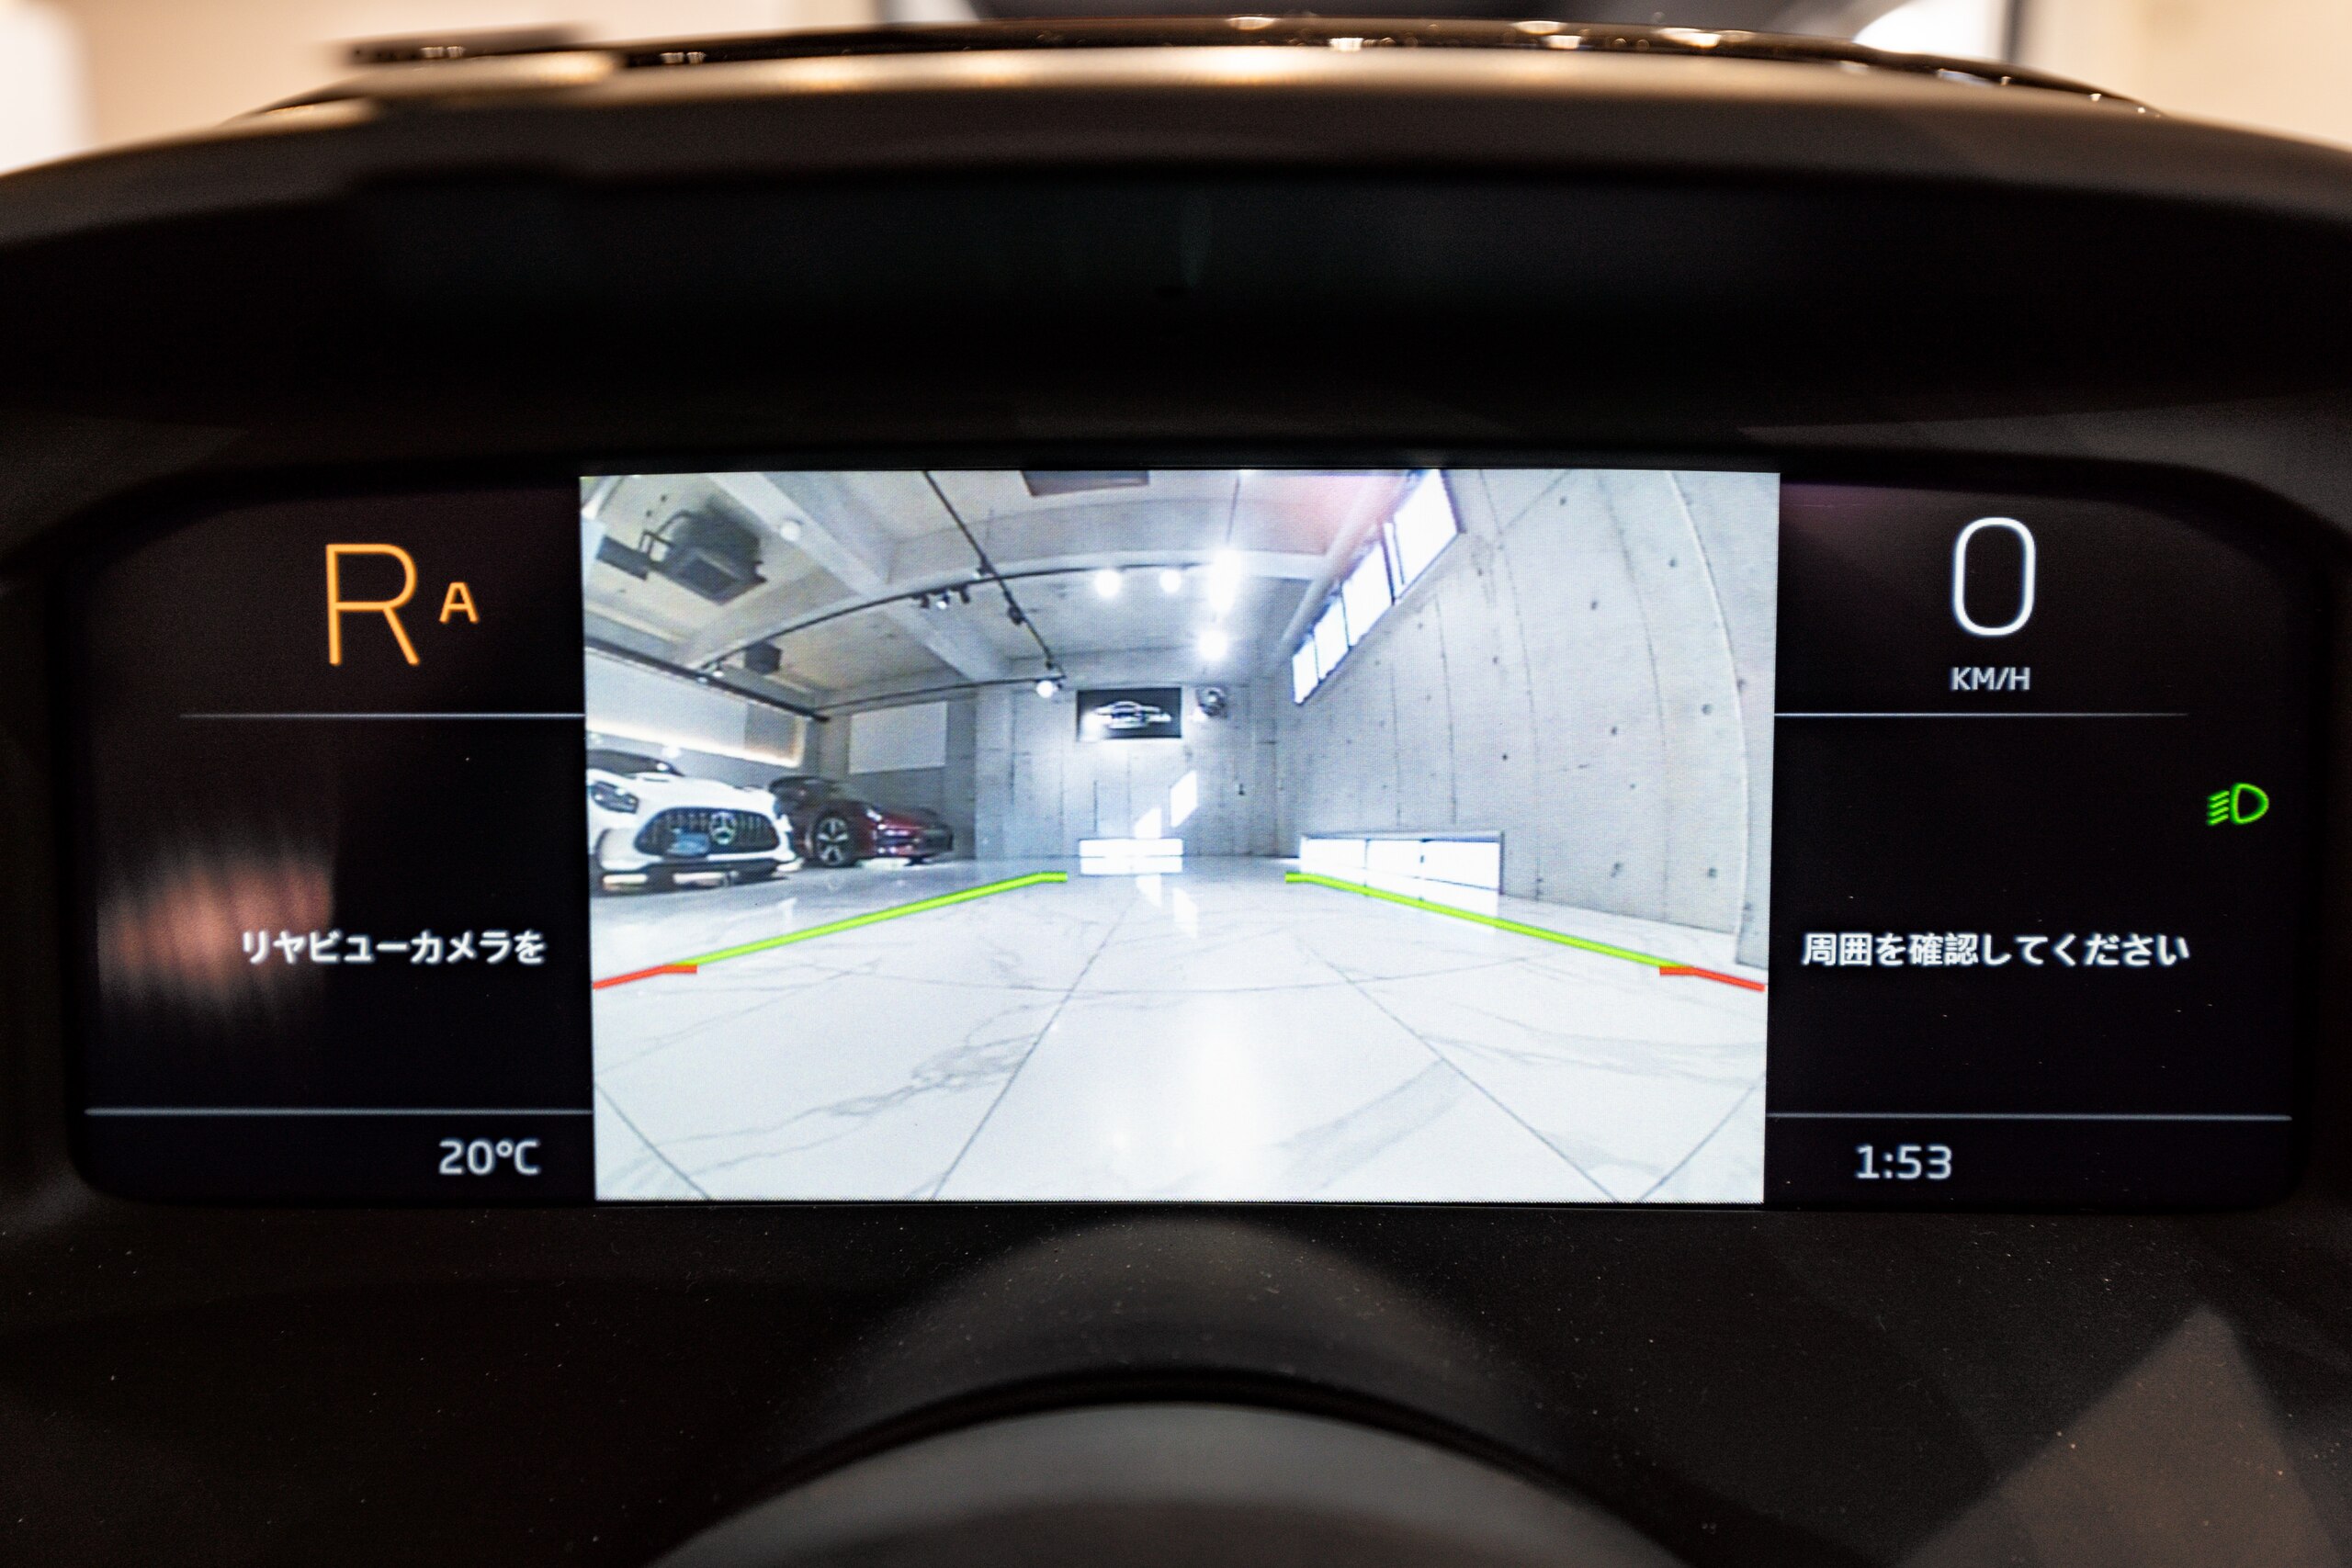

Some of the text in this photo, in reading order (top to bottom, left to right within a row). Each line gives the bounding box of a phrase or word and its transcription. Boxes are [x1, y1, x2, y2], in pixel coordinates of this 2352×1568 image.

[1952, 516, 2037, 637] 0
[325, 543, 479, 666] R A
[1951, 667, 2031, 691] KM/H
[242, 931, 546, 964] リヤビューカメラを
[1802, 932, 2190, 966] 周囲を確認してください
[438, 1139, 539, 1176] 20°C
[1856, 1145, 1953, 1180] 1:53
